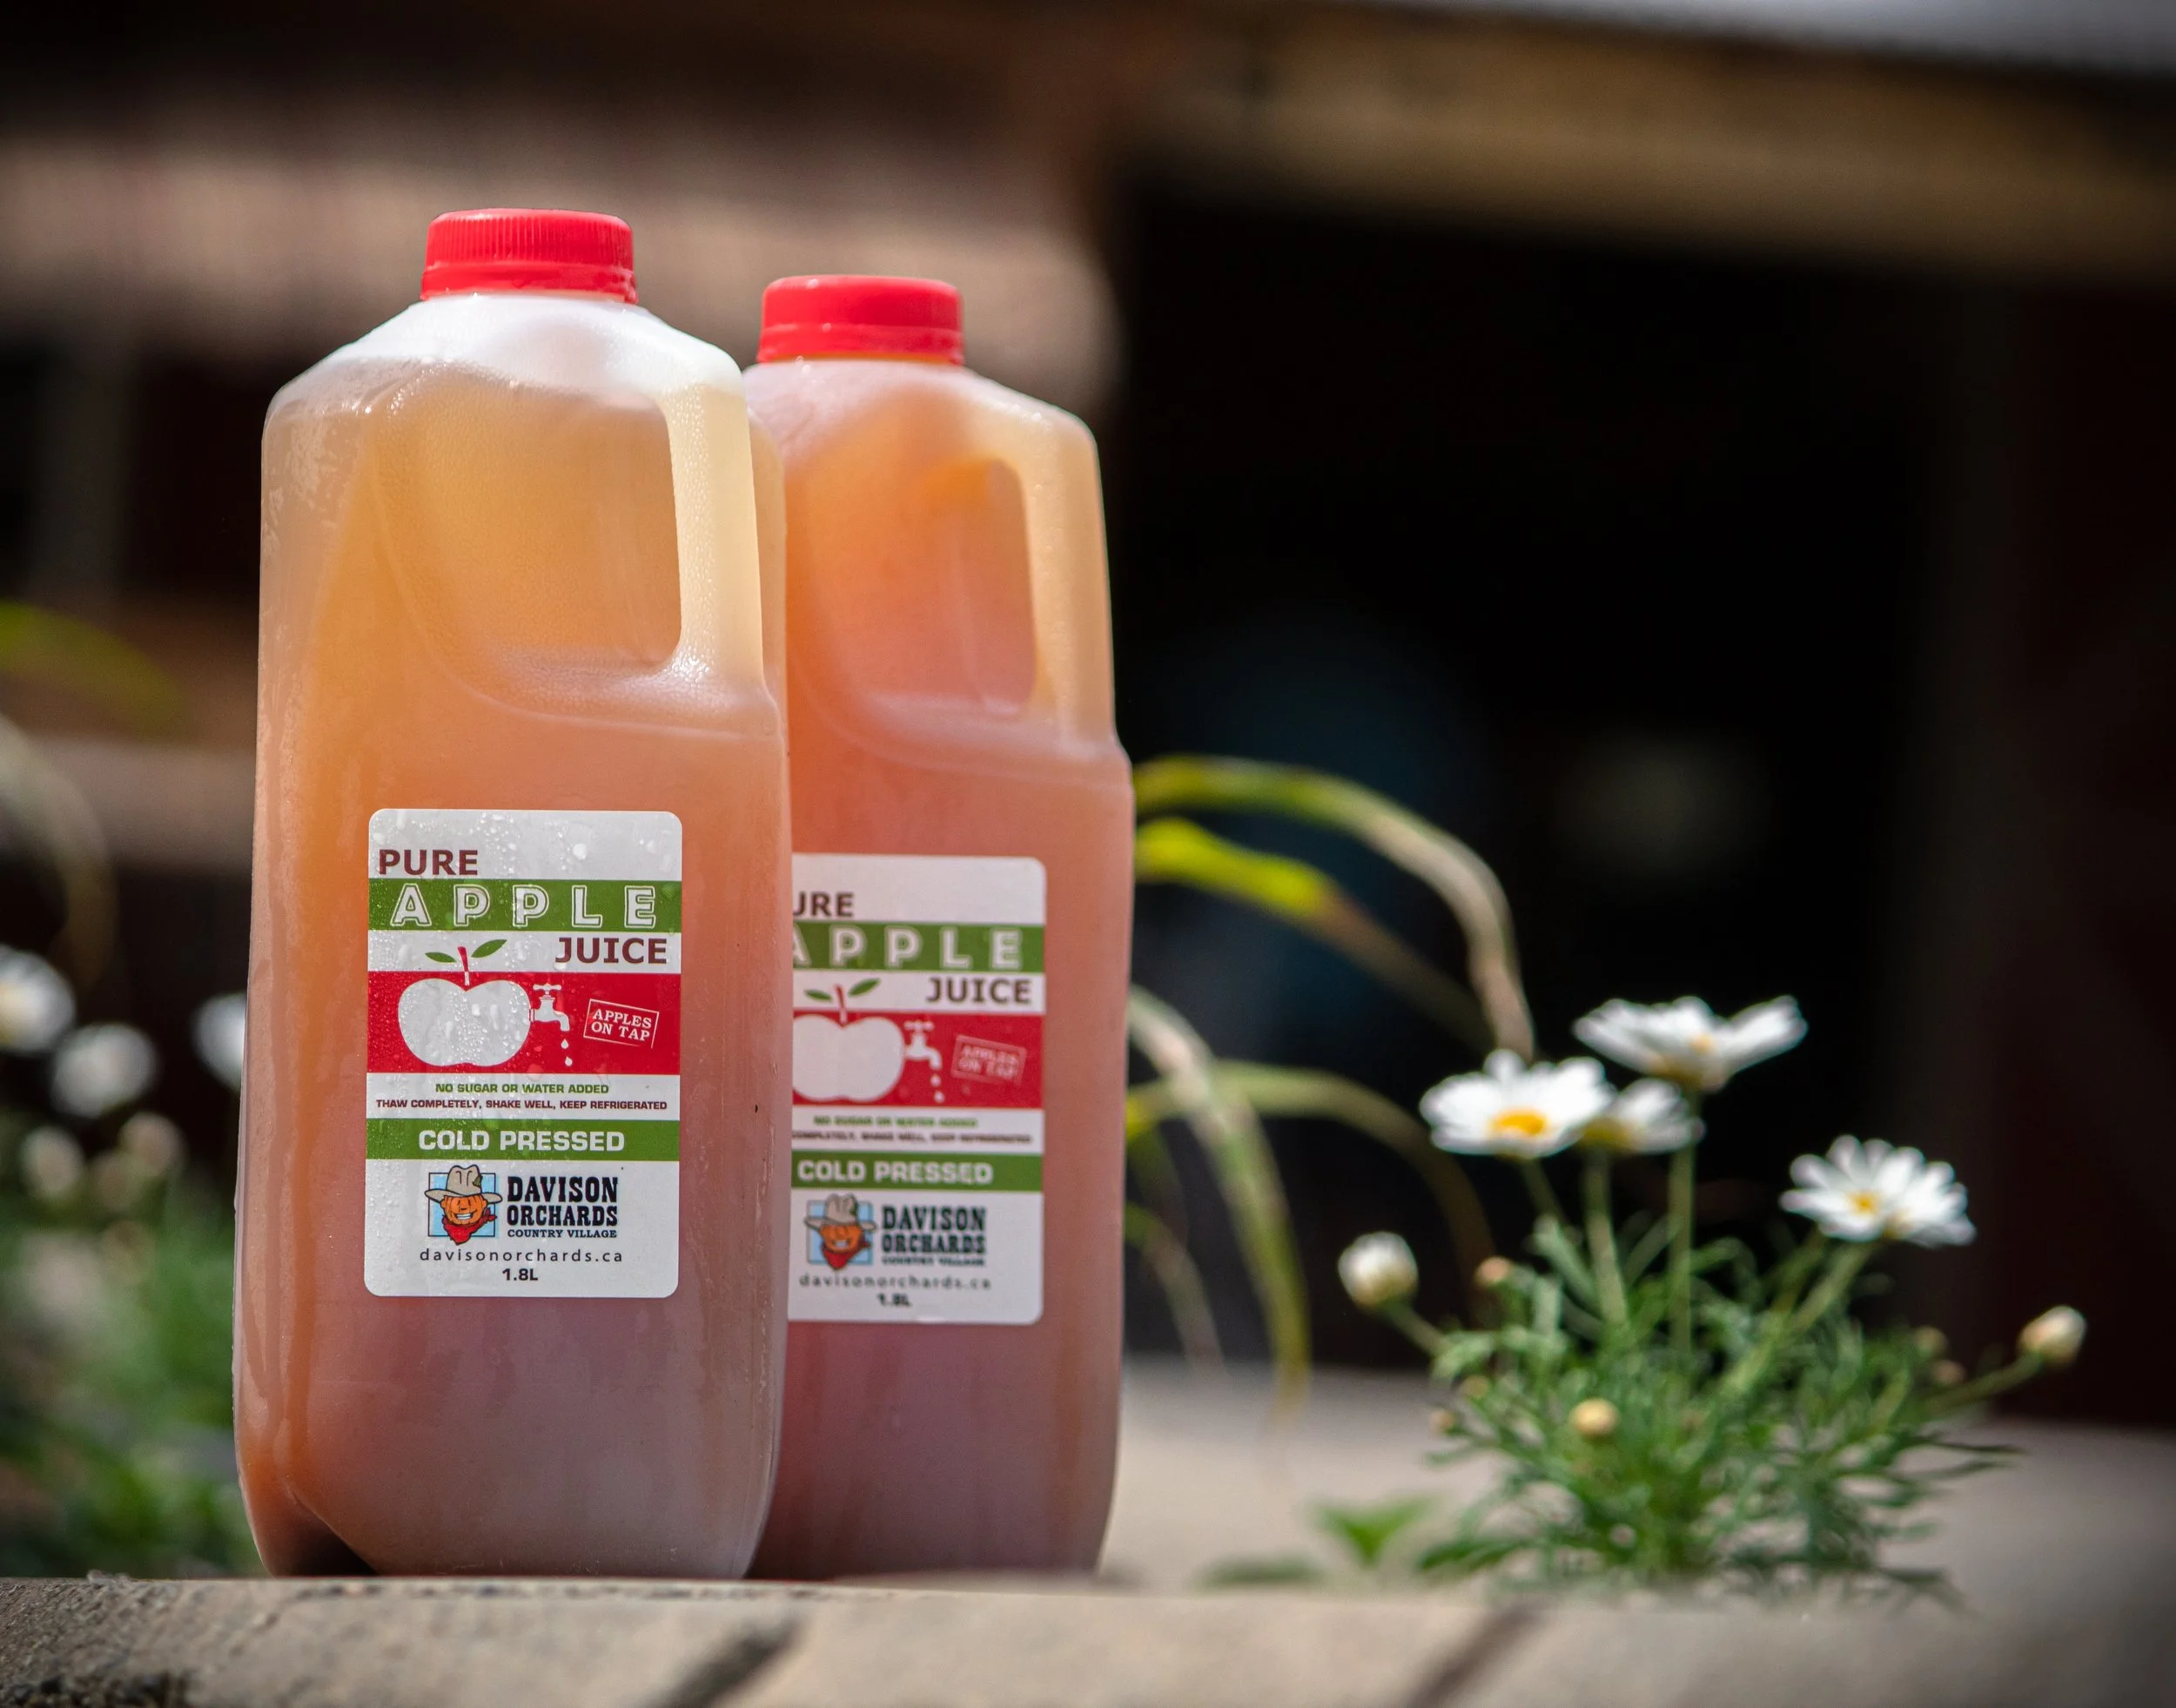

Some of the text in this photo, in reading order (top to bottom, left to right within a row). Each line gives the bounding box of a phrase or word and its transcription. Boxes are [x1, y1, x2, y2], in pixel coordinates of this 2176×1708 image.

[379, 849, 478, 876] PURE
[390, 883, 656, 929] APPLE
[793, 891, 855, 917] URE
[555, 937, 667, 965] JUICE
[926, 977, 1031, 1004] JUICE
[593, 1008, 652, 1029] APPLES
[591, 1021, 650, 1041] ON TAP
[435, 1083, 609, 1094] NO SUGAR OR WATER ADDED
[376, 1099, 668, 1111] THAW COMPLETELY, SHAKE WELL, KEEP REFRIGERATED
[419, 1130, 625, 1152] COLD PRESSED
[797, 1160, 994, 1185] COLD PRESSED
[507, 1176, 619, 1203] DAVISON
[507, 1205, 618, 1227] ORCHARDS
[881, 1205, 986, 1231] DAVISON
[507, 1228, 617, 1238] COUNTRY VILLAGE
[881, 1234, 986, 1254] ORCHARDS
[420, 1247, 622, 1262] davisonorchards.ca
[502, 1268, 539, 1281] 1.8L
